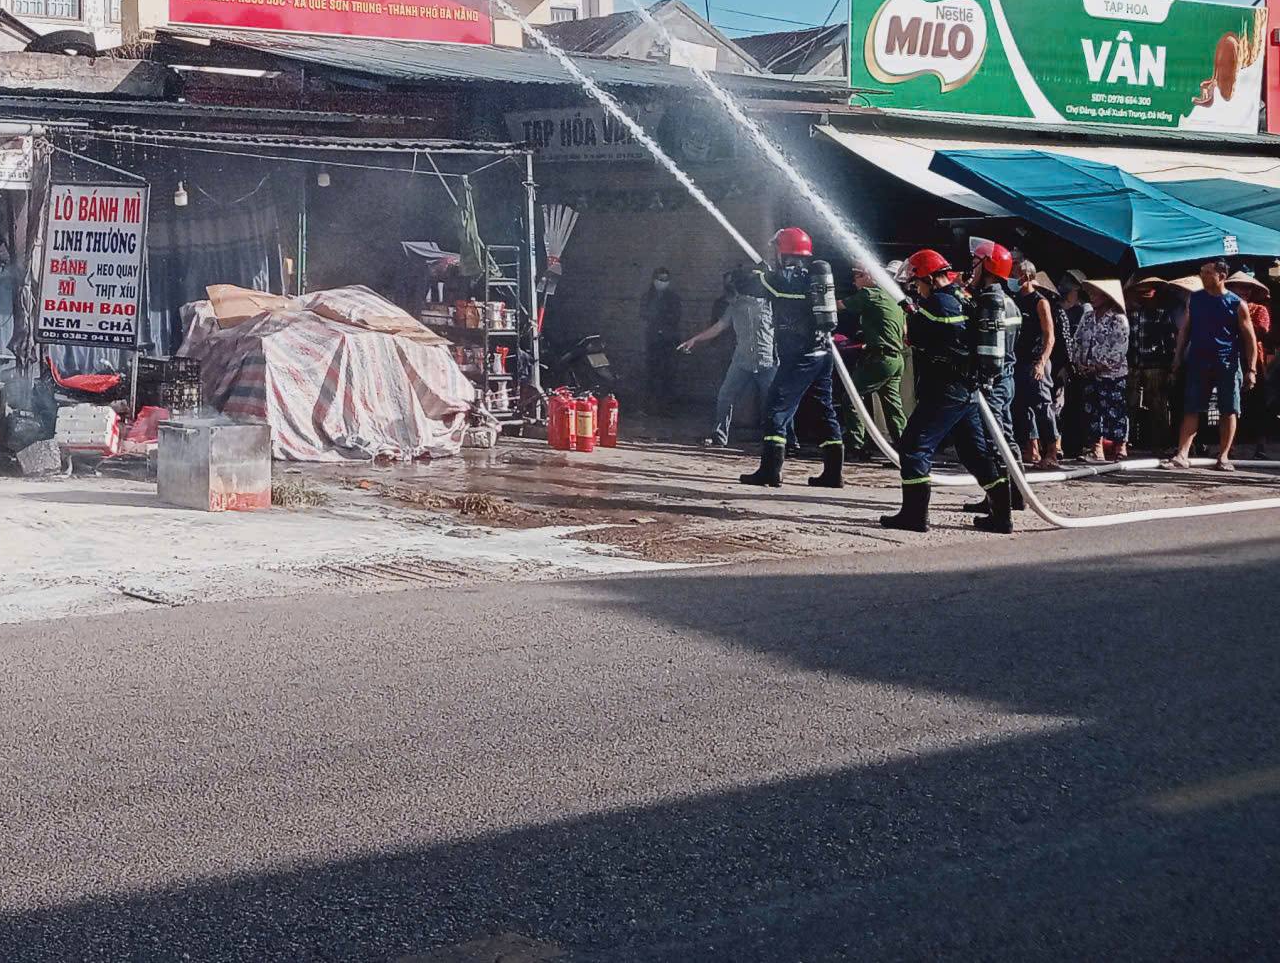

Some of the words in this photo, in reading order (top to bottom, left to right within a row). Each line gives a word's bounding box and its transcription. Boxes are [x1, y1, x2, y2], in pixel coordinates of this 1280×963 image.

[420, 3, 439, 18] PHỐ
[440, 7, 452, 20] ĐÀ
[936, 5, 974, 24] Nestlé
[885, 15, 974, 61] MILO
[1081, 29, 1167, 87] VÂN
[1065, 104, 1079, 116] Chợ
[54, 189, 74, 221] LÒ
[78, 189, 119, 223] BÁNH
[123, 192, 141, 224] MÌ
[53, 230, 84, 252] LINH
[86, 227, 137, 254] THƯƠNG
[50, 255, 88, 277] BÁNH
[97, 263, 115, 277] HEO
[116, 264, 139, 279] QUAY
[58, 276, 77, 297] MÌ
[95, 284, 118, 300] THỊT
[119, 282, 136, 299] XÍU
[44, 298, 94, 314] BÁNH
[100, 302, 136, 316] BAO
[43, 317, 81, 329] NEM
[98, 318, 133, 333] CHẢ
